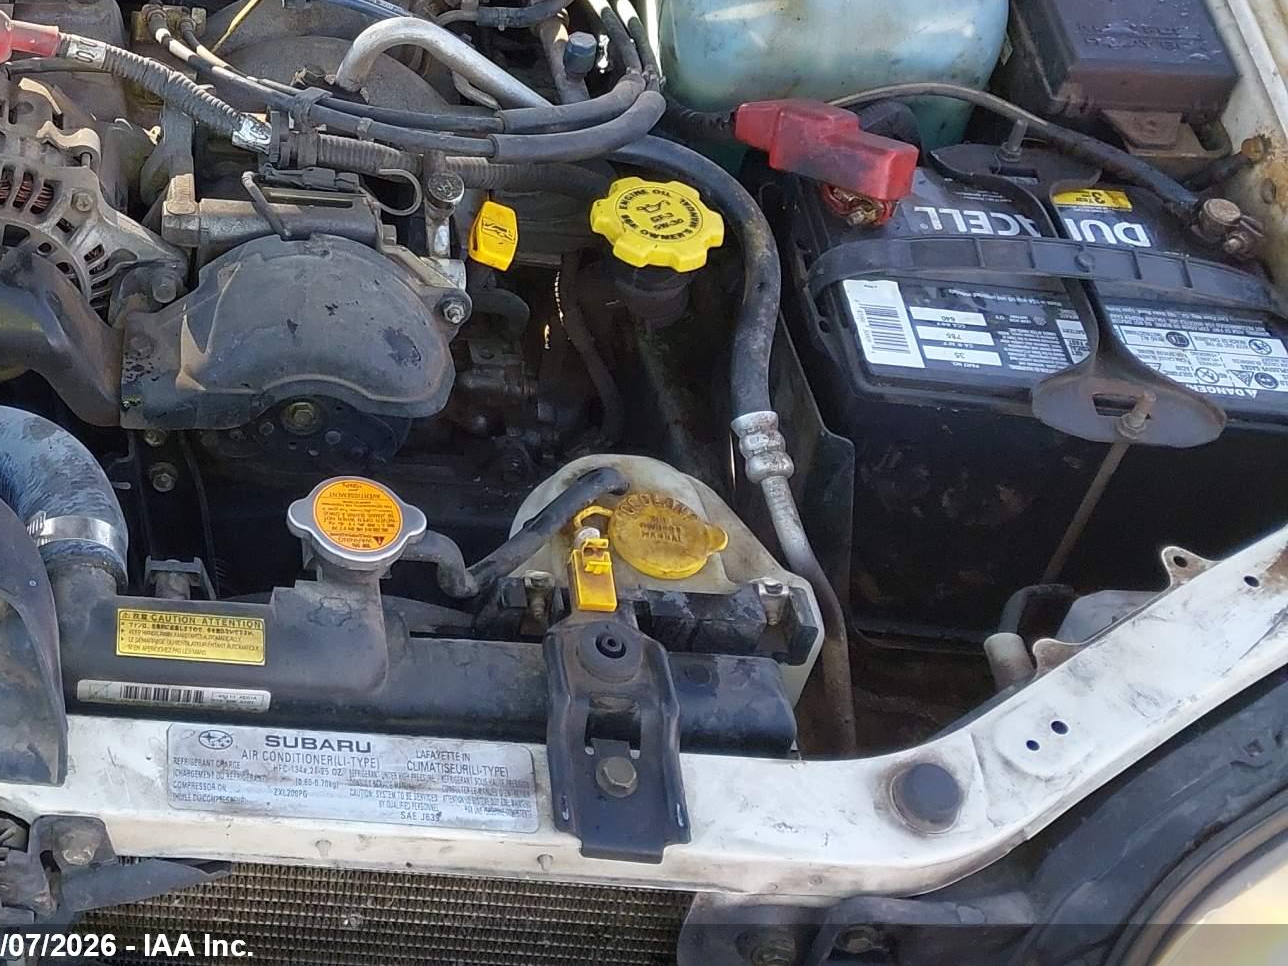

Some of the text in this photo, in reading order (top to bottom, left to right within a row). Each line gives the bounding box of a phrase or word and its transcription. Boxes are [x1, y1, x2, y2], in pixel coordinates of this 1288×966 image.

[619, 189, 672, 210] ENGINE OIL
[1092, 191, 1106, 204] 3
[621, 214, 639, 229] SEE
[679, 197, 700, 229] MANUAL
[151, 614, 196, 624] CAUTION
[201, 617, 261, 629] ATTENTION
[265, 734, 372, 754] SUBARU
[241, 749, 380, 770] AIR CONDITIONER(LI-TYPE)
[415, 749, 461, 761] LAFAYETTE
[406, 760, 509, 778] CLIMATISEUR(LI-TYPE)
[173, 781, 217, 791] COMPRESSOR
[400, 811, 417, 820] SAE
